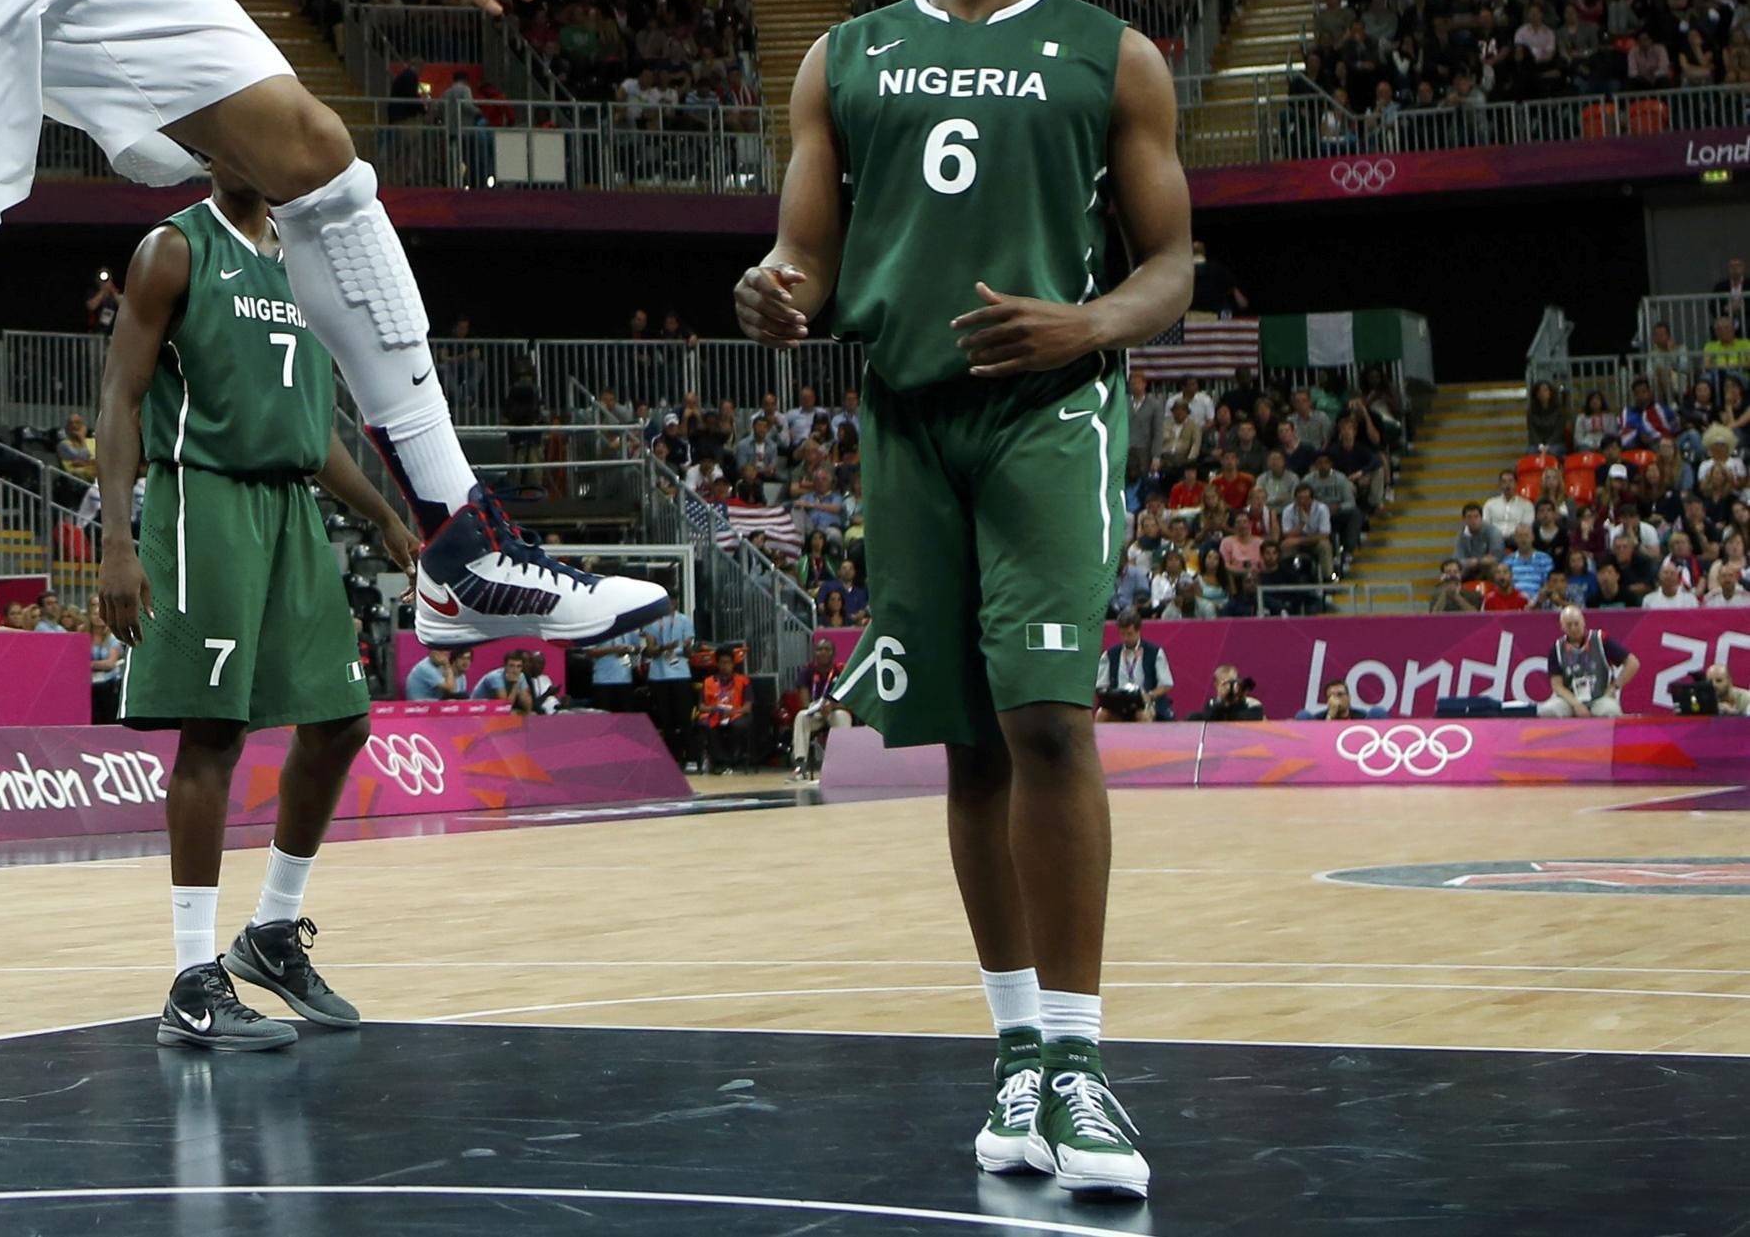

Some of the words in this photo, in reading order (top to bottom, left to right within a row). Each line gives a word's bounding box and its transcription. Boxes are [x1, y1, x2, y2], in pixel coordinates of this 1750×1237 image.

[878, 67, 1048, 101] NIGERIA
[923, 118, 979, 195] 6
[269, 332, 297, 387] 7
[204, 638, 237, 686] 7
[875, 635, 908, 702] 6
[80, 751, 167, 804] 2012
